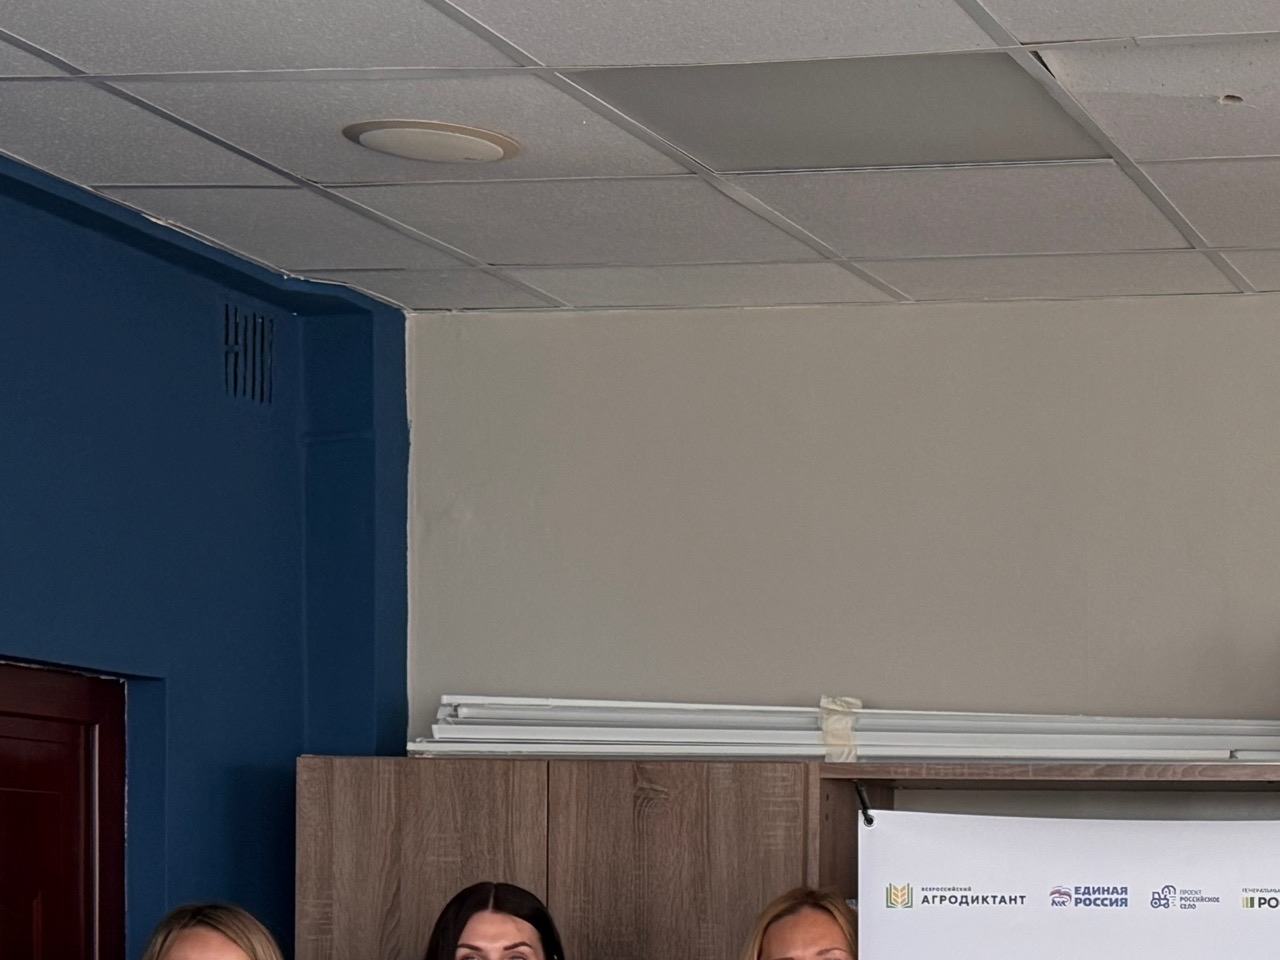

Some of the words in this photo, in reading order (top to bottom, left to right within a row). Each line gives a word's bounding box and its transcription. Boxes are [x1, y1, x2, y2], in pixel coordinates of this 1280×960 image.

[1074, 886, 1128, 896] ЕДИНАЯ
[921, 894, 1027, 907] АГРОДИКТАНТ
[1074, 897, 1128, 908] РОССИЯ
